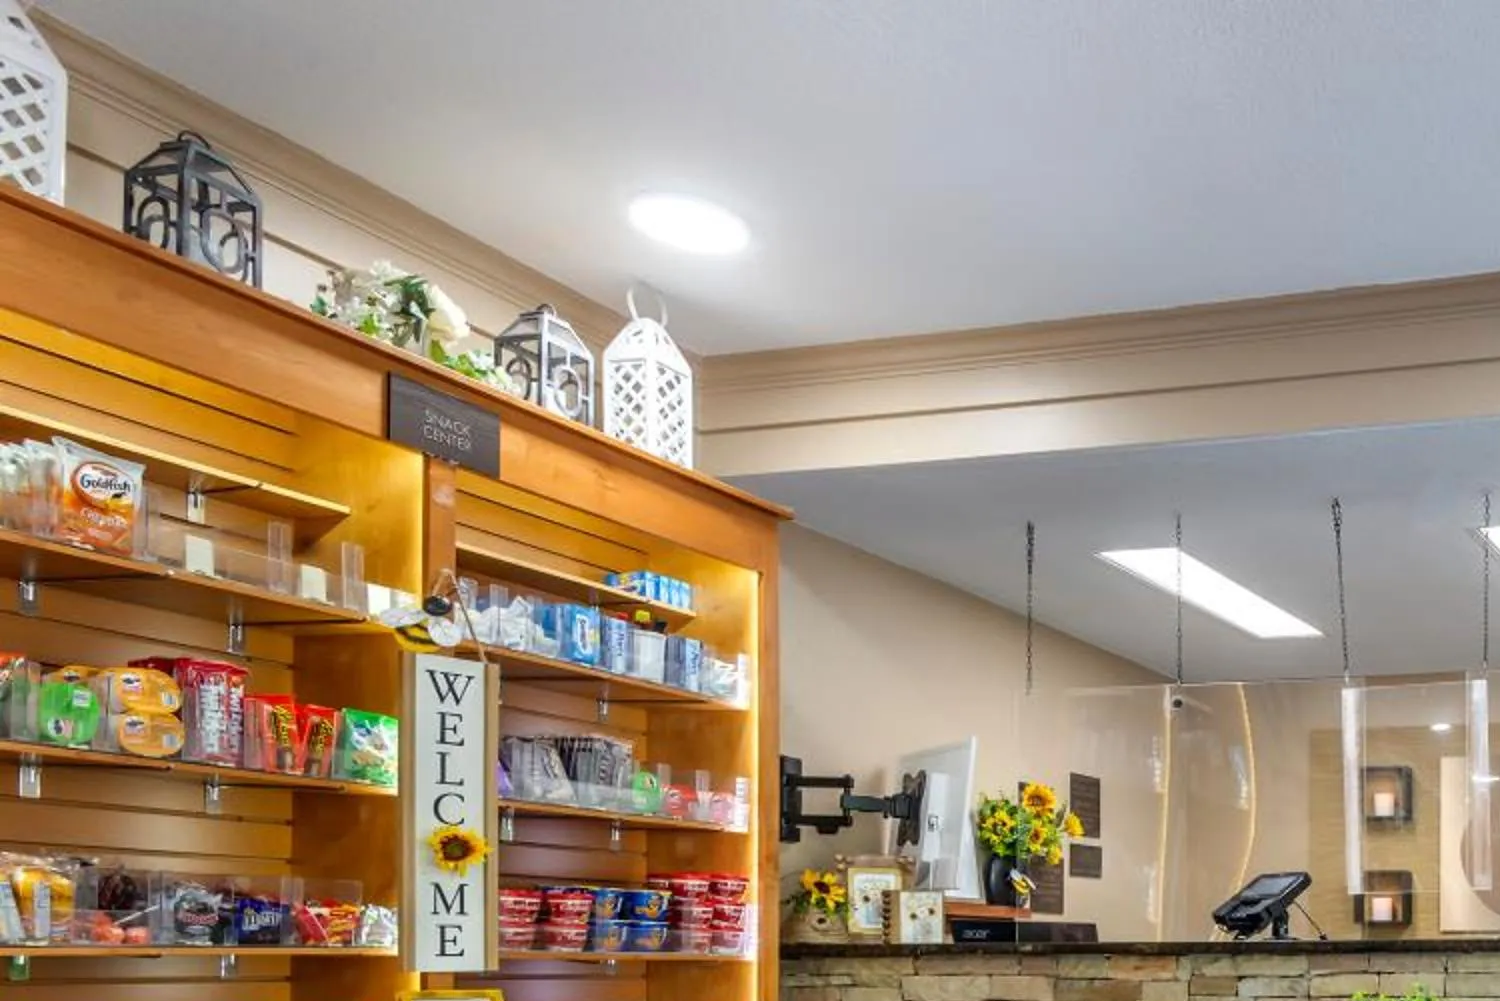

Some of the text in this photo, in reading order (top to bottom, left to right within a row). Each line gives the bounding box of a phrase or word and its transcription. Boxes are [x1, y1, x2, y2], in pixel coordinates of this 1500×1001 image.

[424, 409, 471, 438] SNACK
[423, 425, 473, 453] CENTER
[80, 473, 131, 492] Goldfish
[425, 669, 475, 957] WELCME
[961, 929, 991, 939] acer
